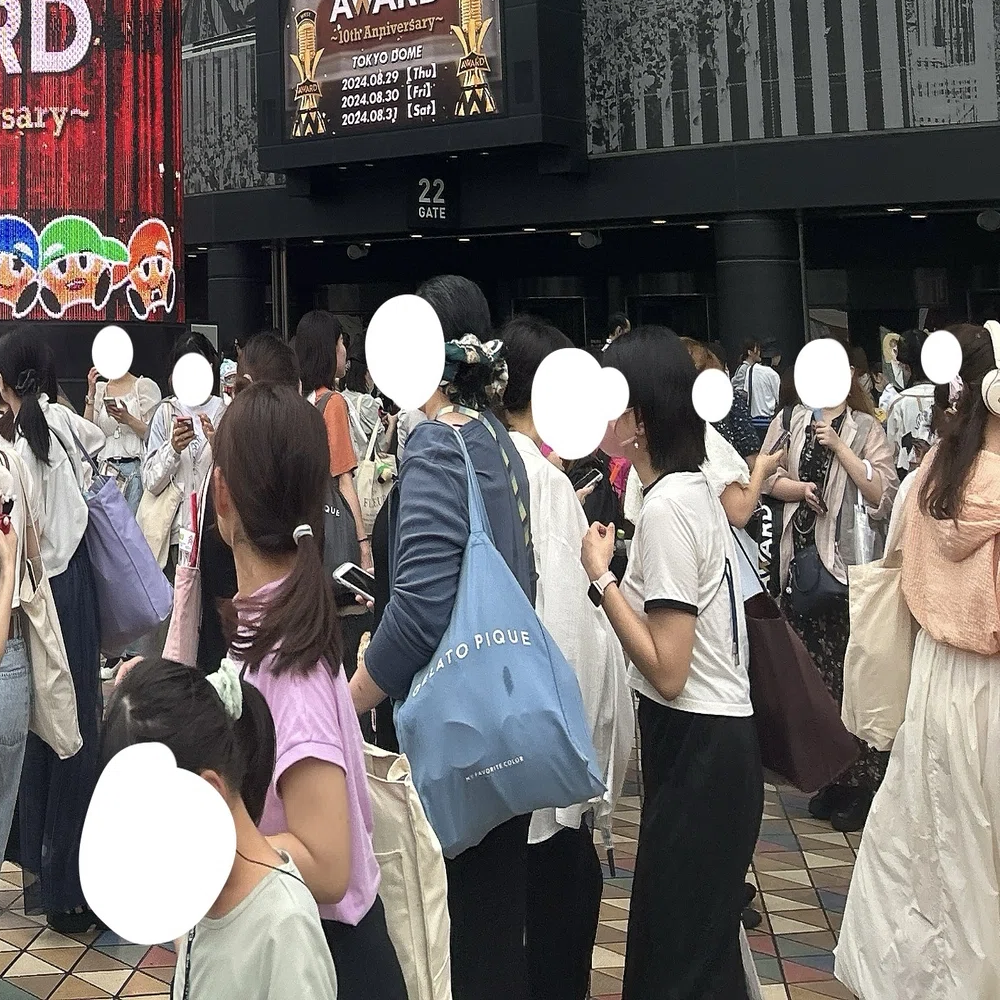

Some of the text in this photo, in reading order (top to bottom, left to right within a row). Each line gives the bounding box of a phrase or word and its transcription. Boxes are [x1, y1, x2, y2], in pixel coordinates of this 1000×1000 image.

[352, 45, 423, 69] TOKYO DOME
[341, 69, 399, 91] 2024.08.29
[341, 88, 400, 108] 2024.08.30
[341, 107, 398, 126] 2024.08.31
[418, 177, 445, 204] 22
[418, 206, 446, 219] GATE
[474, 629, 531, 650] PIQUE
[503, 756, 524, 768] COLOR
